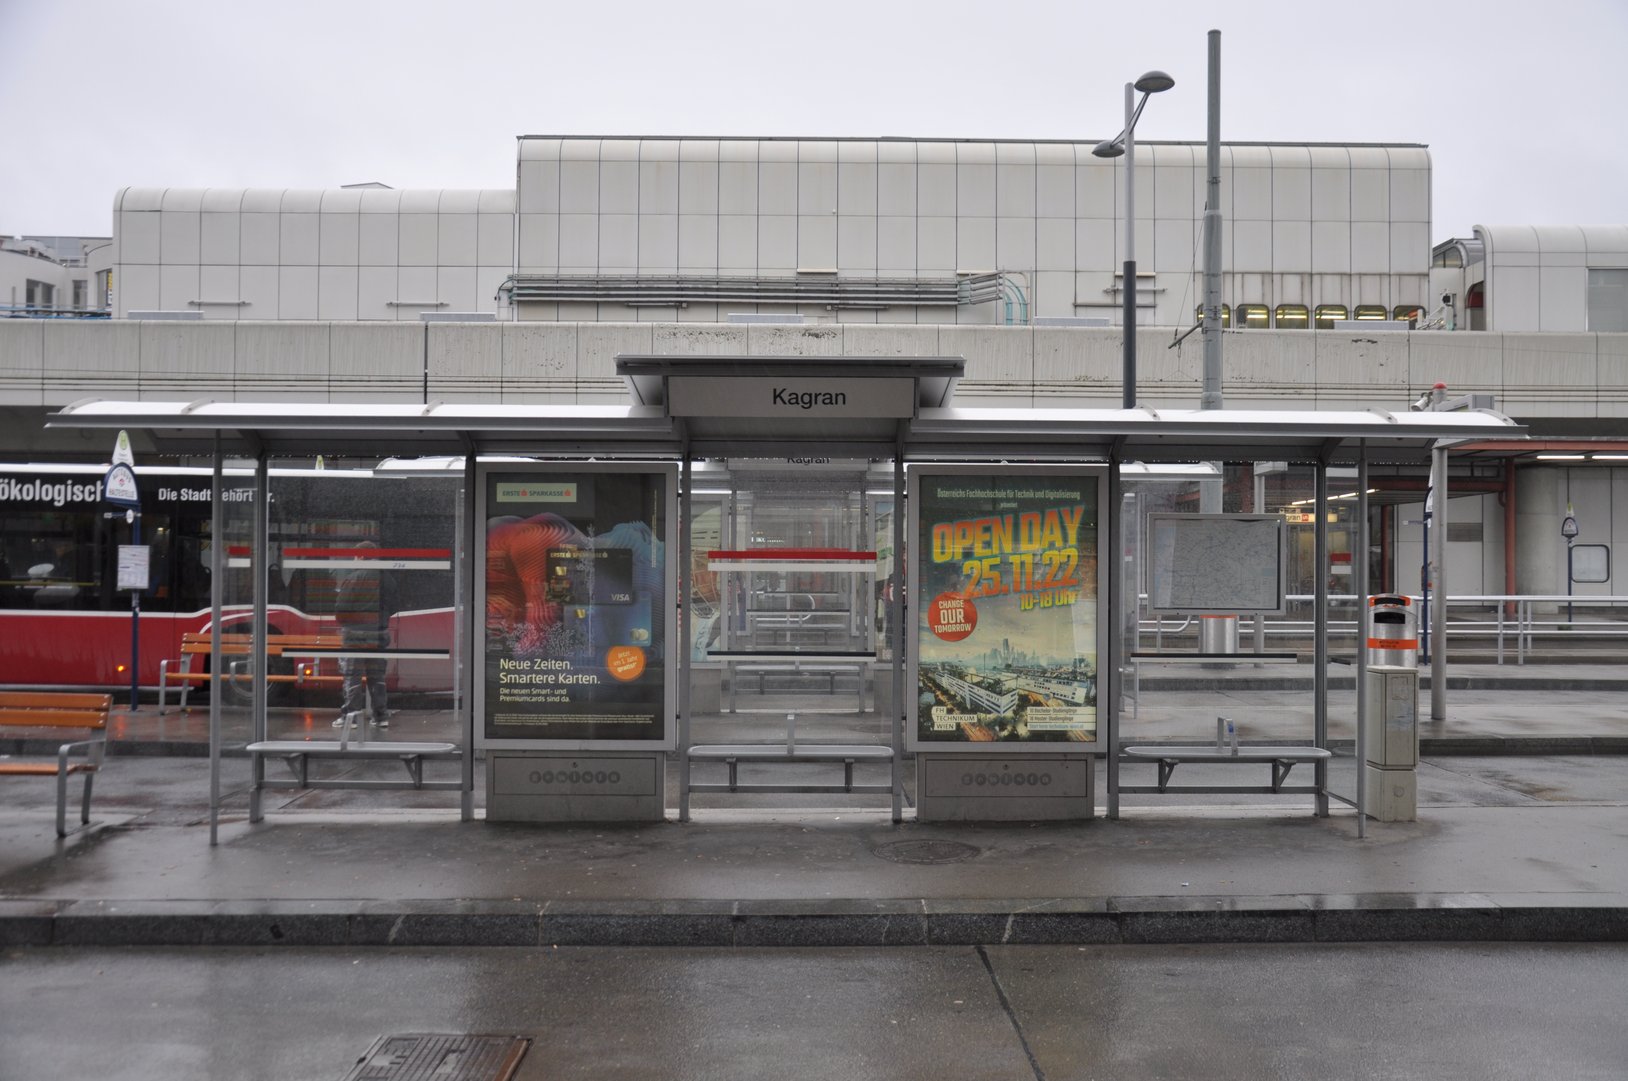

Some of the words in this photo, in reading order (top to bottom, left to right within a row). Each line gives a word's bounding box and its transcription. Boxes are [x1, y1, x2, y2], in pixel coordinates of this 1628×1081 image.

[772, 388, 846, 409] Kagran
[158, 488, 178, 501] Die
[180, 488, 212, 501] Stadt
[221, 489, 254, 502] ehört
[1015, 488, 1034, 498] Technik
[1034, 489, 1045, 498] und
[932, 513, 1014, 564] OPEN
[1019, 504, 1085, 553] DAY
[962, 547, 1080, 600] 25.11.22
[938, 599, 965, 609] CHANGE
[940, 608, 965, 624] OUR
[934, 623, 972, 634] TOMORROW
[500, 658, 531, 670] Neue
[533, 658, 574, 670] Zeiten.
[499, 672, 556, 684] Smartere
[558, 672, 601, 684] Karten.
[500, 687, 510, 695] Die
[554, 687, 567, 695] und
[500, 695, 546, 703] Premiumcards
[561, 695, 571, 703] da.
